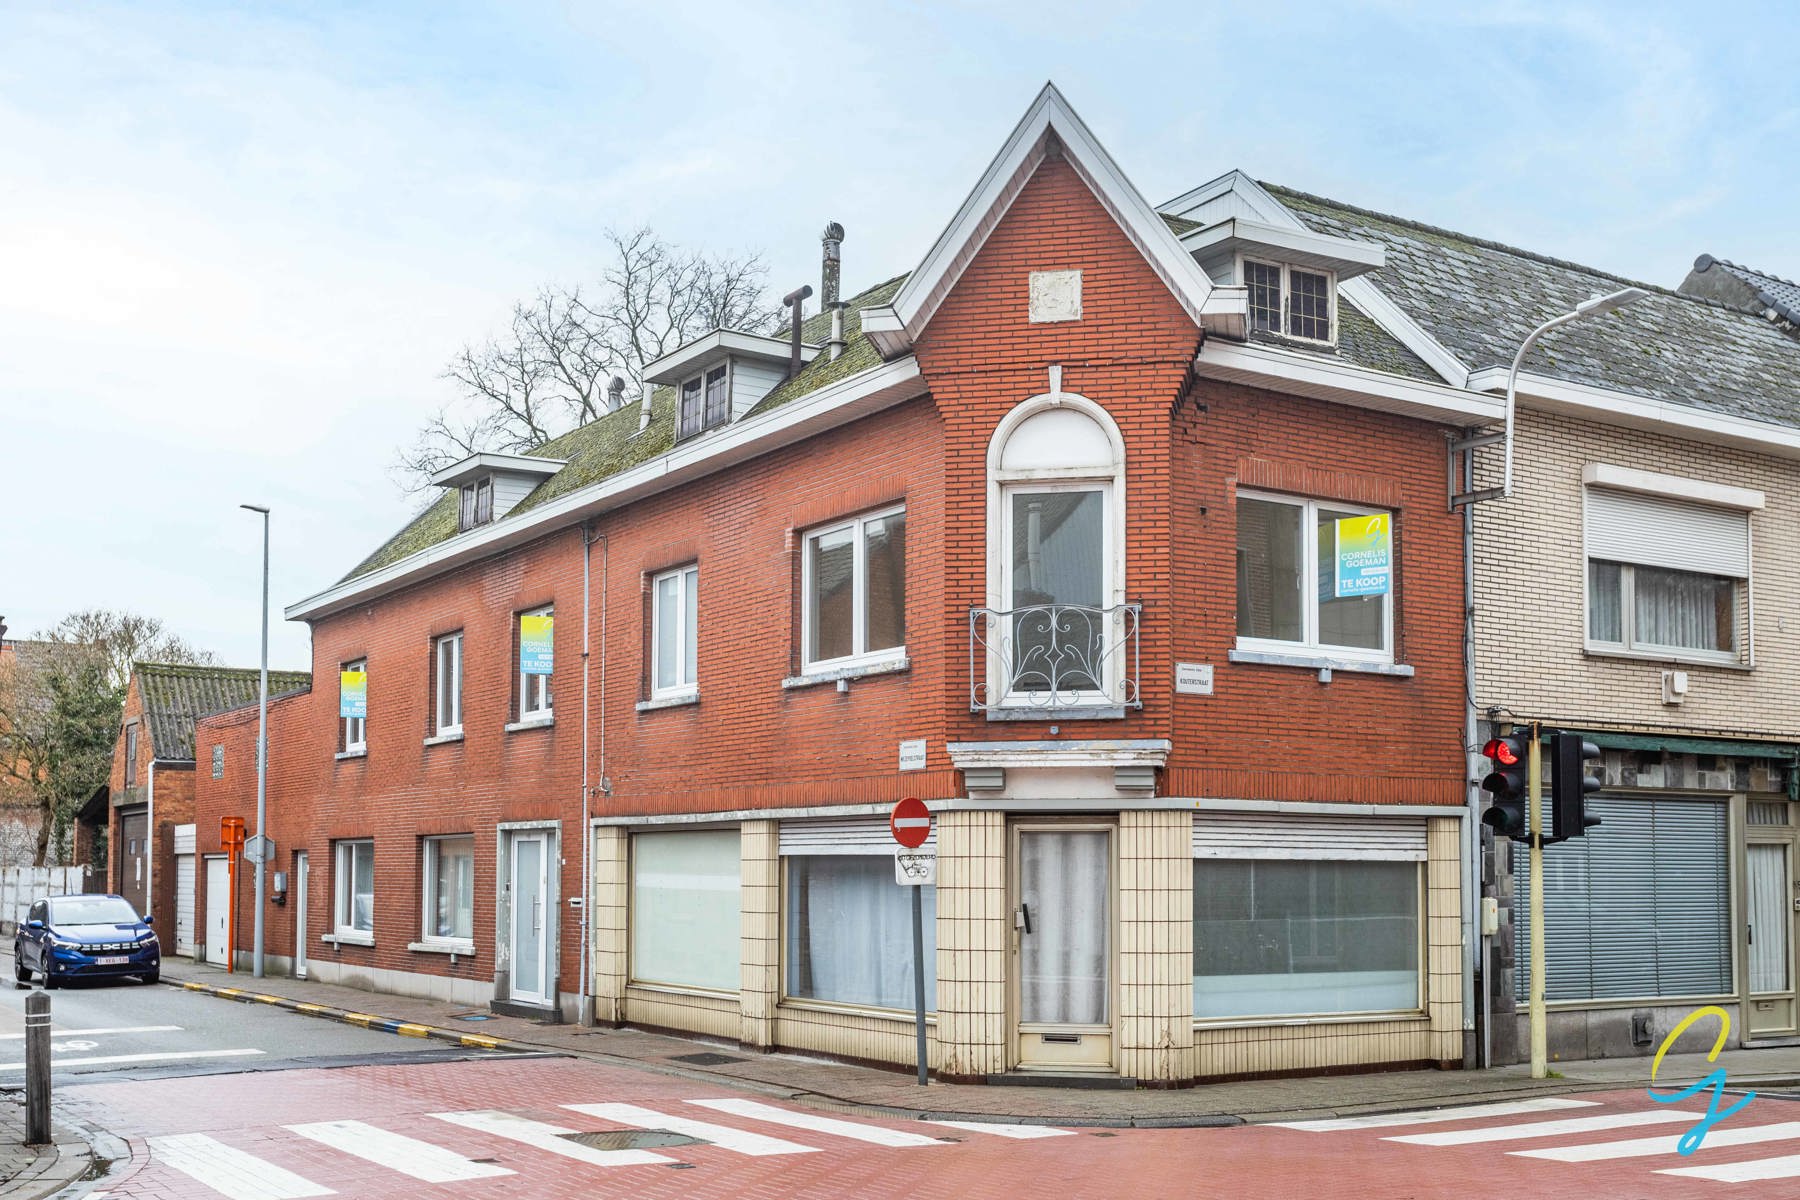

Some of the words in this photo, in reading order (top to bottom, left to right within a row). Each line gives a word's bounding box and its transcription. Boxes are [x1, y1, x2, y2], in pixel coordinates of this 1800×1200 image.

[1341, 549, 1386, 561] CORNELIS
[1345, 557, 1386, 568] GOEMAN
[1342, 579, 1353, 589] TE
[1356, 576, 1386, 587] KOOP
[534, 660, 553, 668] KOO
